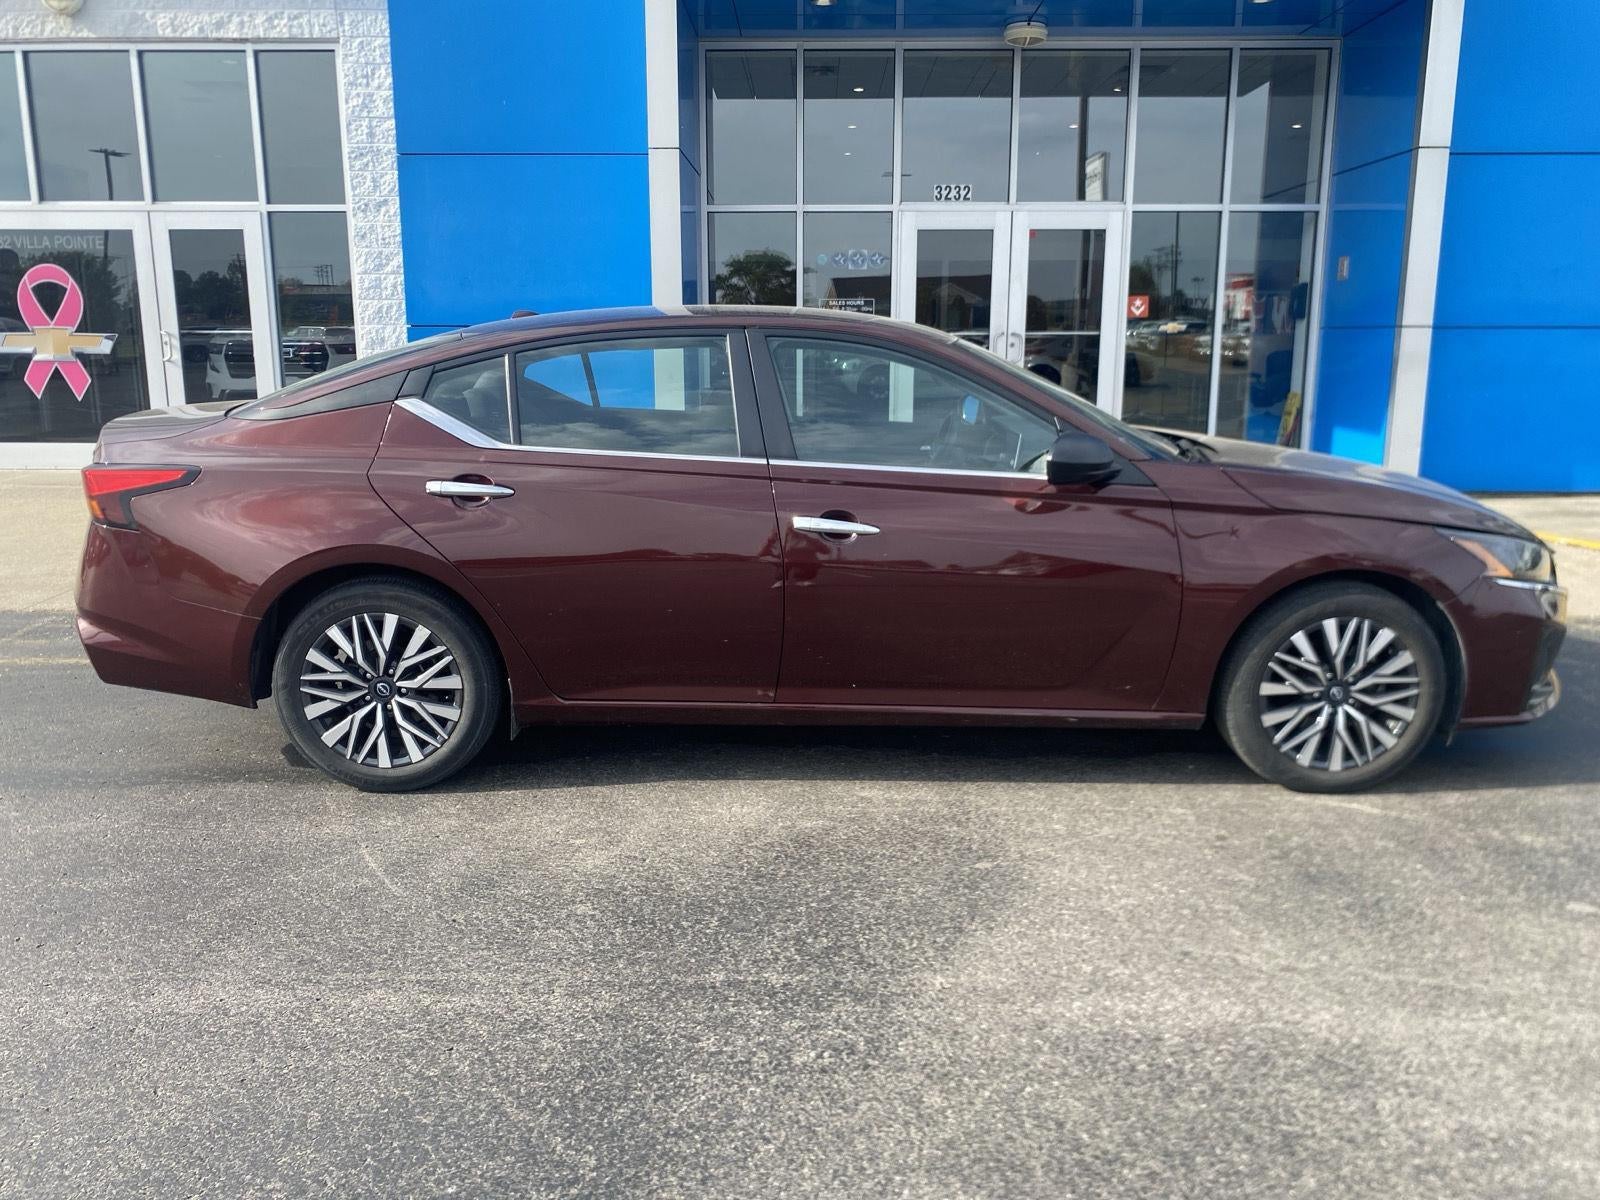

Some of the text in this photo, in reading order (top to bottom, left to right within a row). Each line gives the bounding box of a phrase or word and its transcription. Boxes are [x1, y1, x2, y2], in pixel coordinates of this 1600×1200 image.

[934, 185, 971, 201] 3232
[13, 235, 51, 249] VILLA
[54, 235, 105, 249] POINTE
